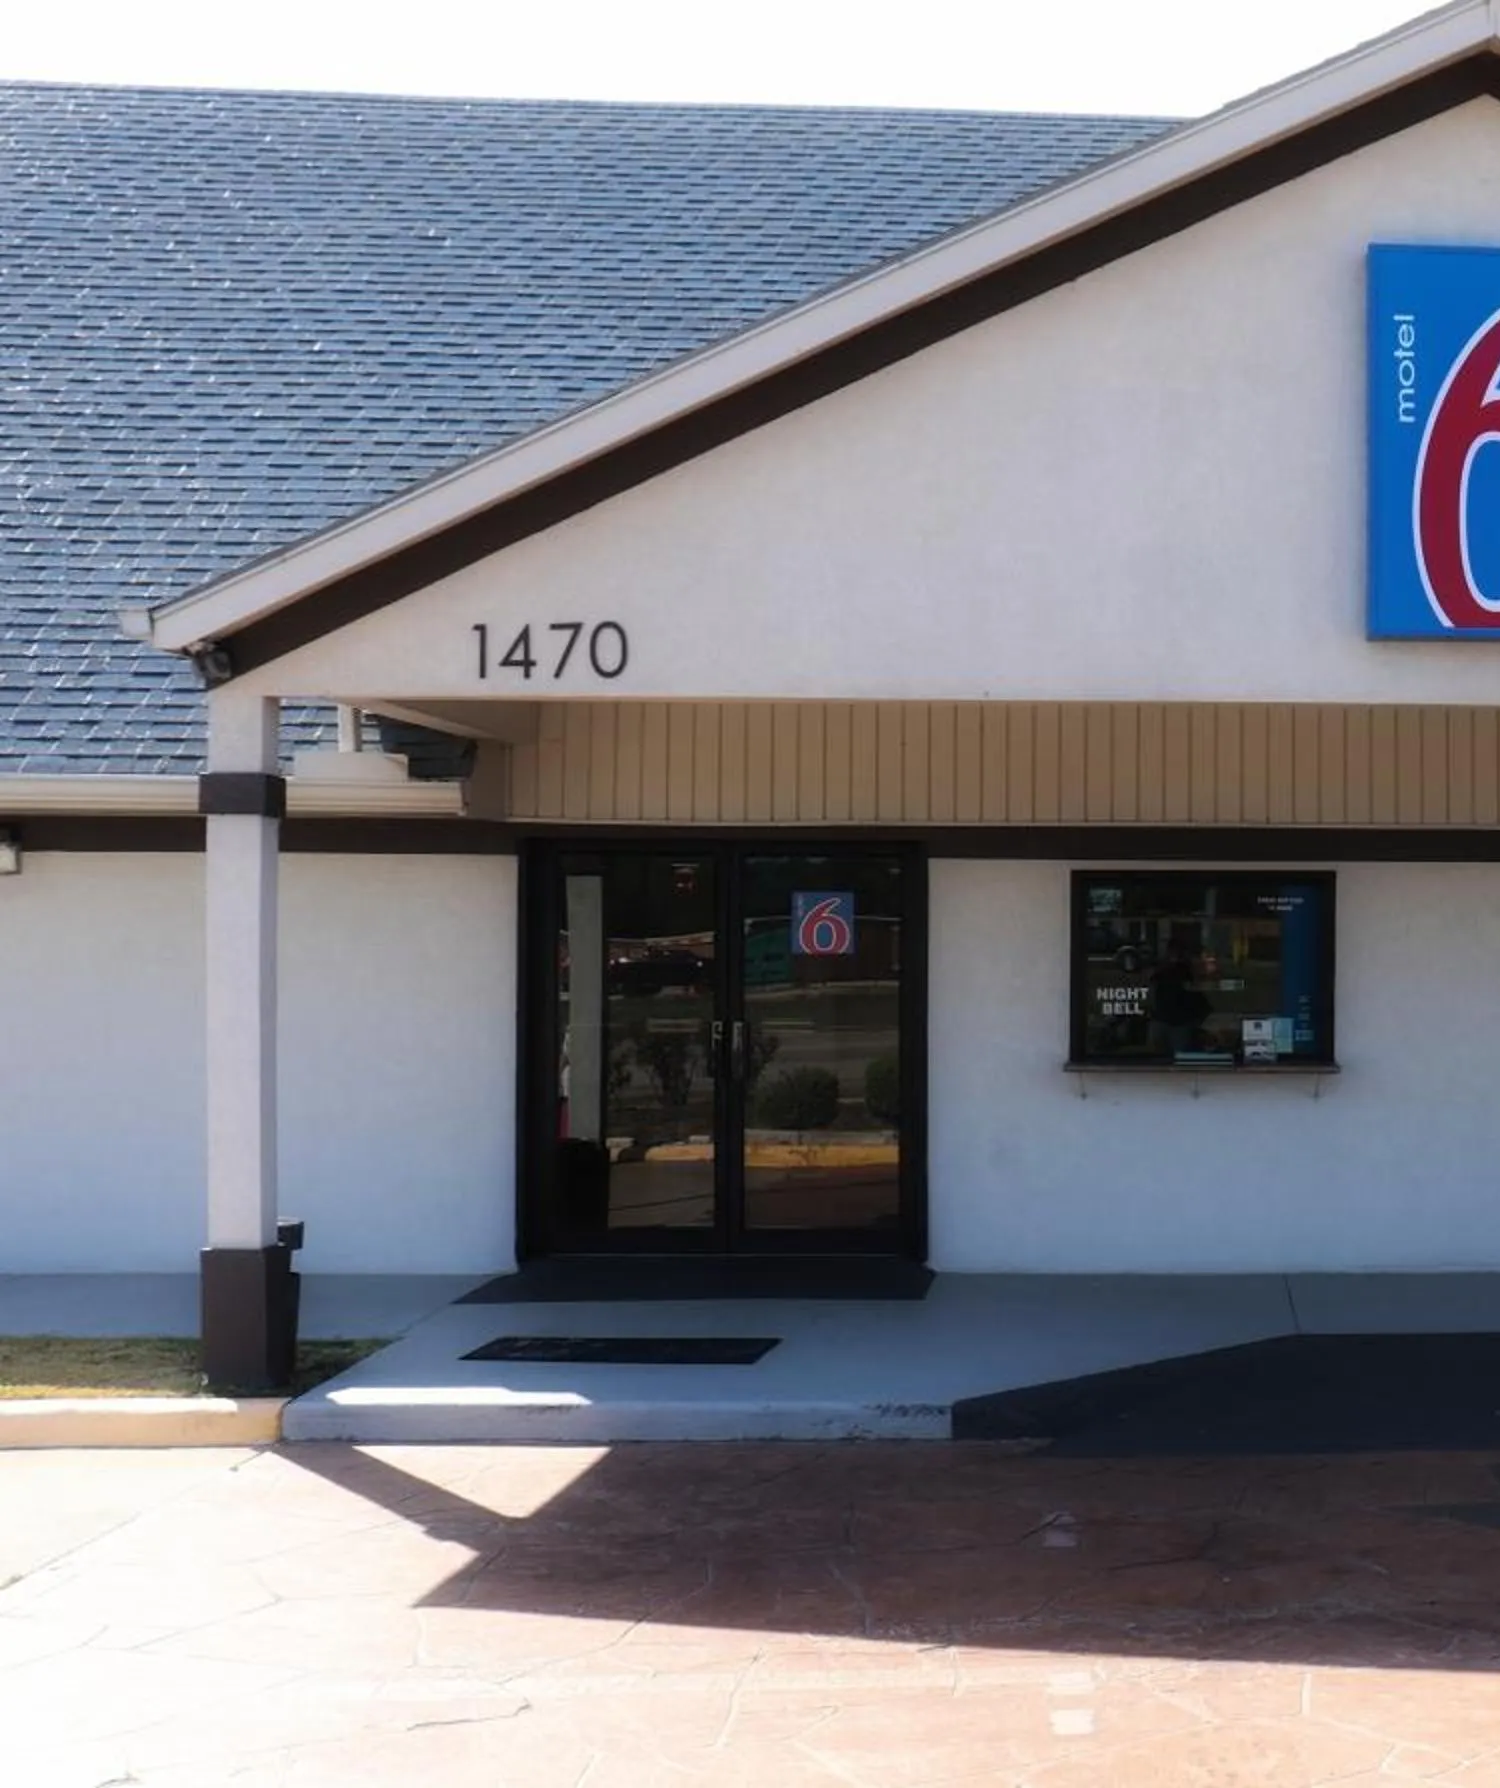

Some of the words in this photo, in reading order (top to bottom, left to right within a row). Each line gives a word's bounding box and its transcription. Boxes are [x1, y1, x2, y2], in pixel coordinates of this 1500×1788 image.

[1393, 314, 1415, 423] motel
[471, 620, 628, 680] 1470
[799, 896, 851, 957] 6
[1096, 986, 1149, 1000] NIGHT
[1102, 1002, 1145, 1015] BELL
